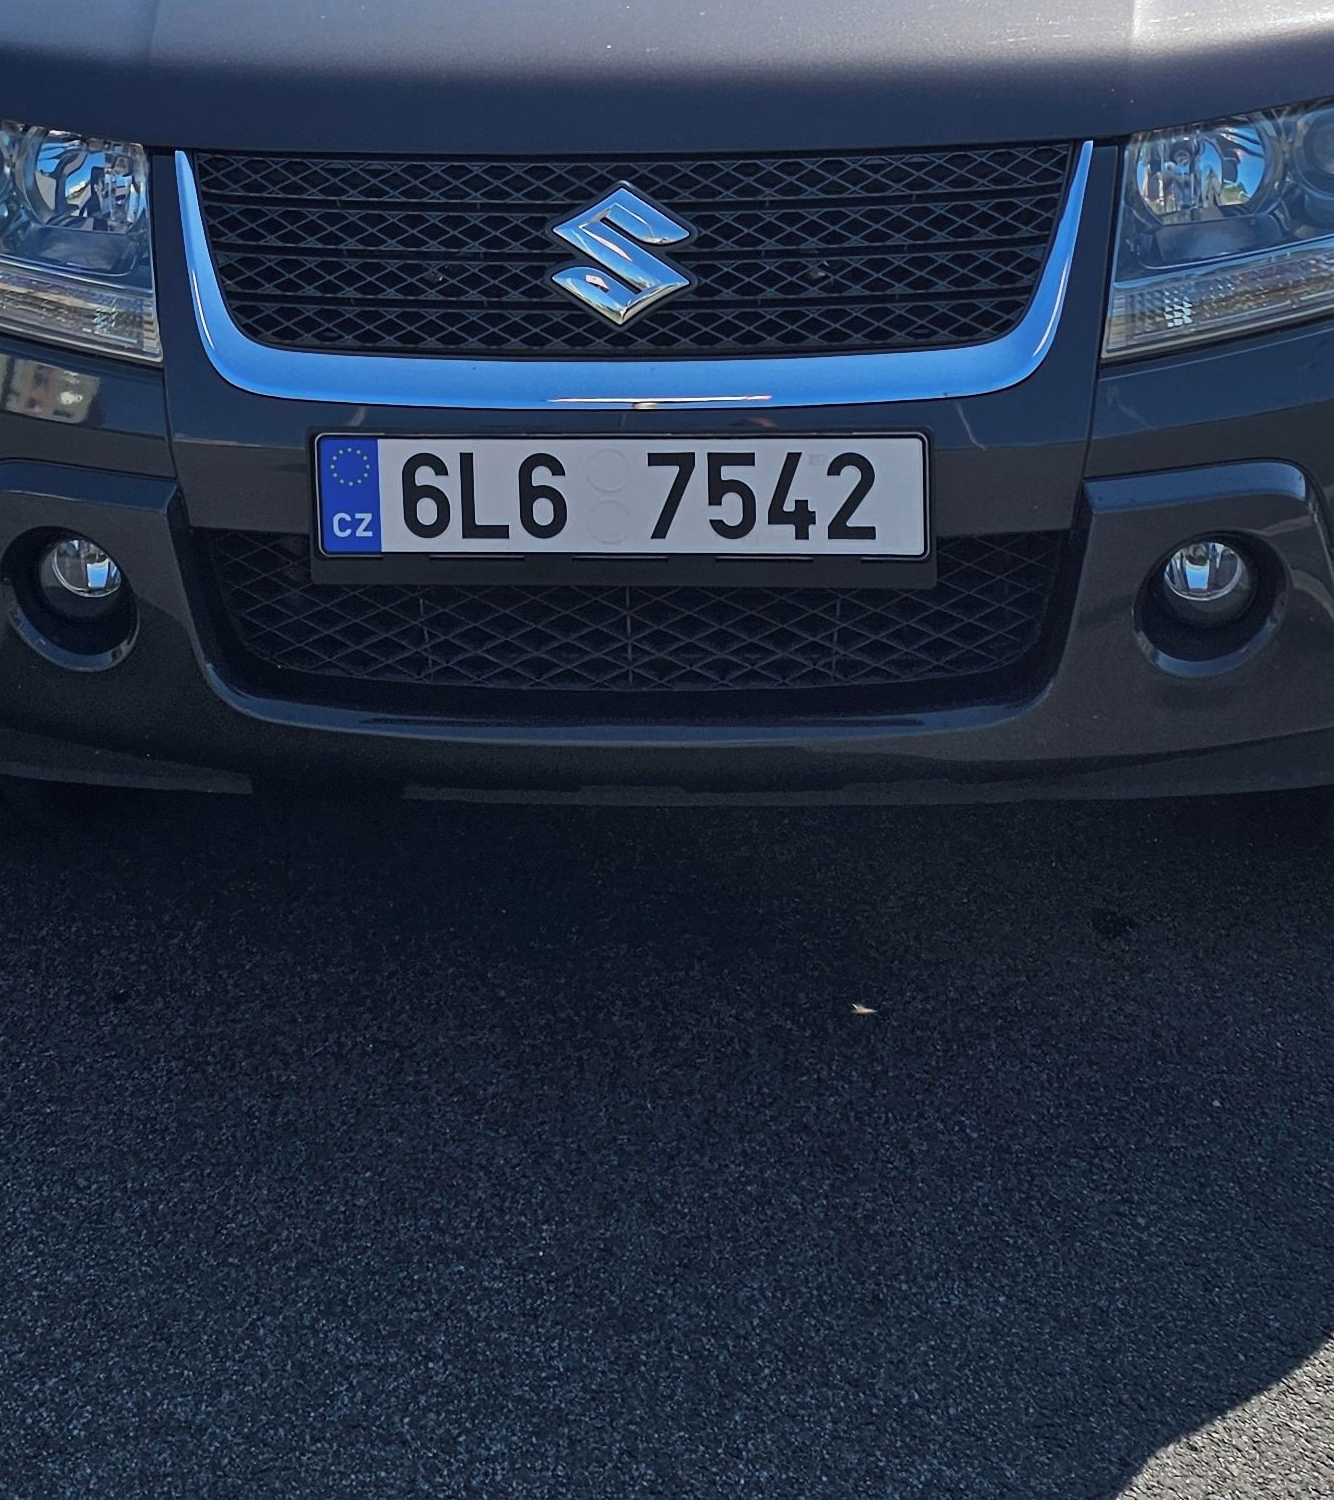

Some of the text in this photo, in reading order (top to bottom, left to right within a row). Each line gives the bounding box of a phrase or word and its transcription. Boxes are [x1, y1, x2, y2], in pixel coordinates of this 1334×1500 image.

[333, 512, 373, 538] CZ
[401, 452, 877, 541] 6L6 7542
